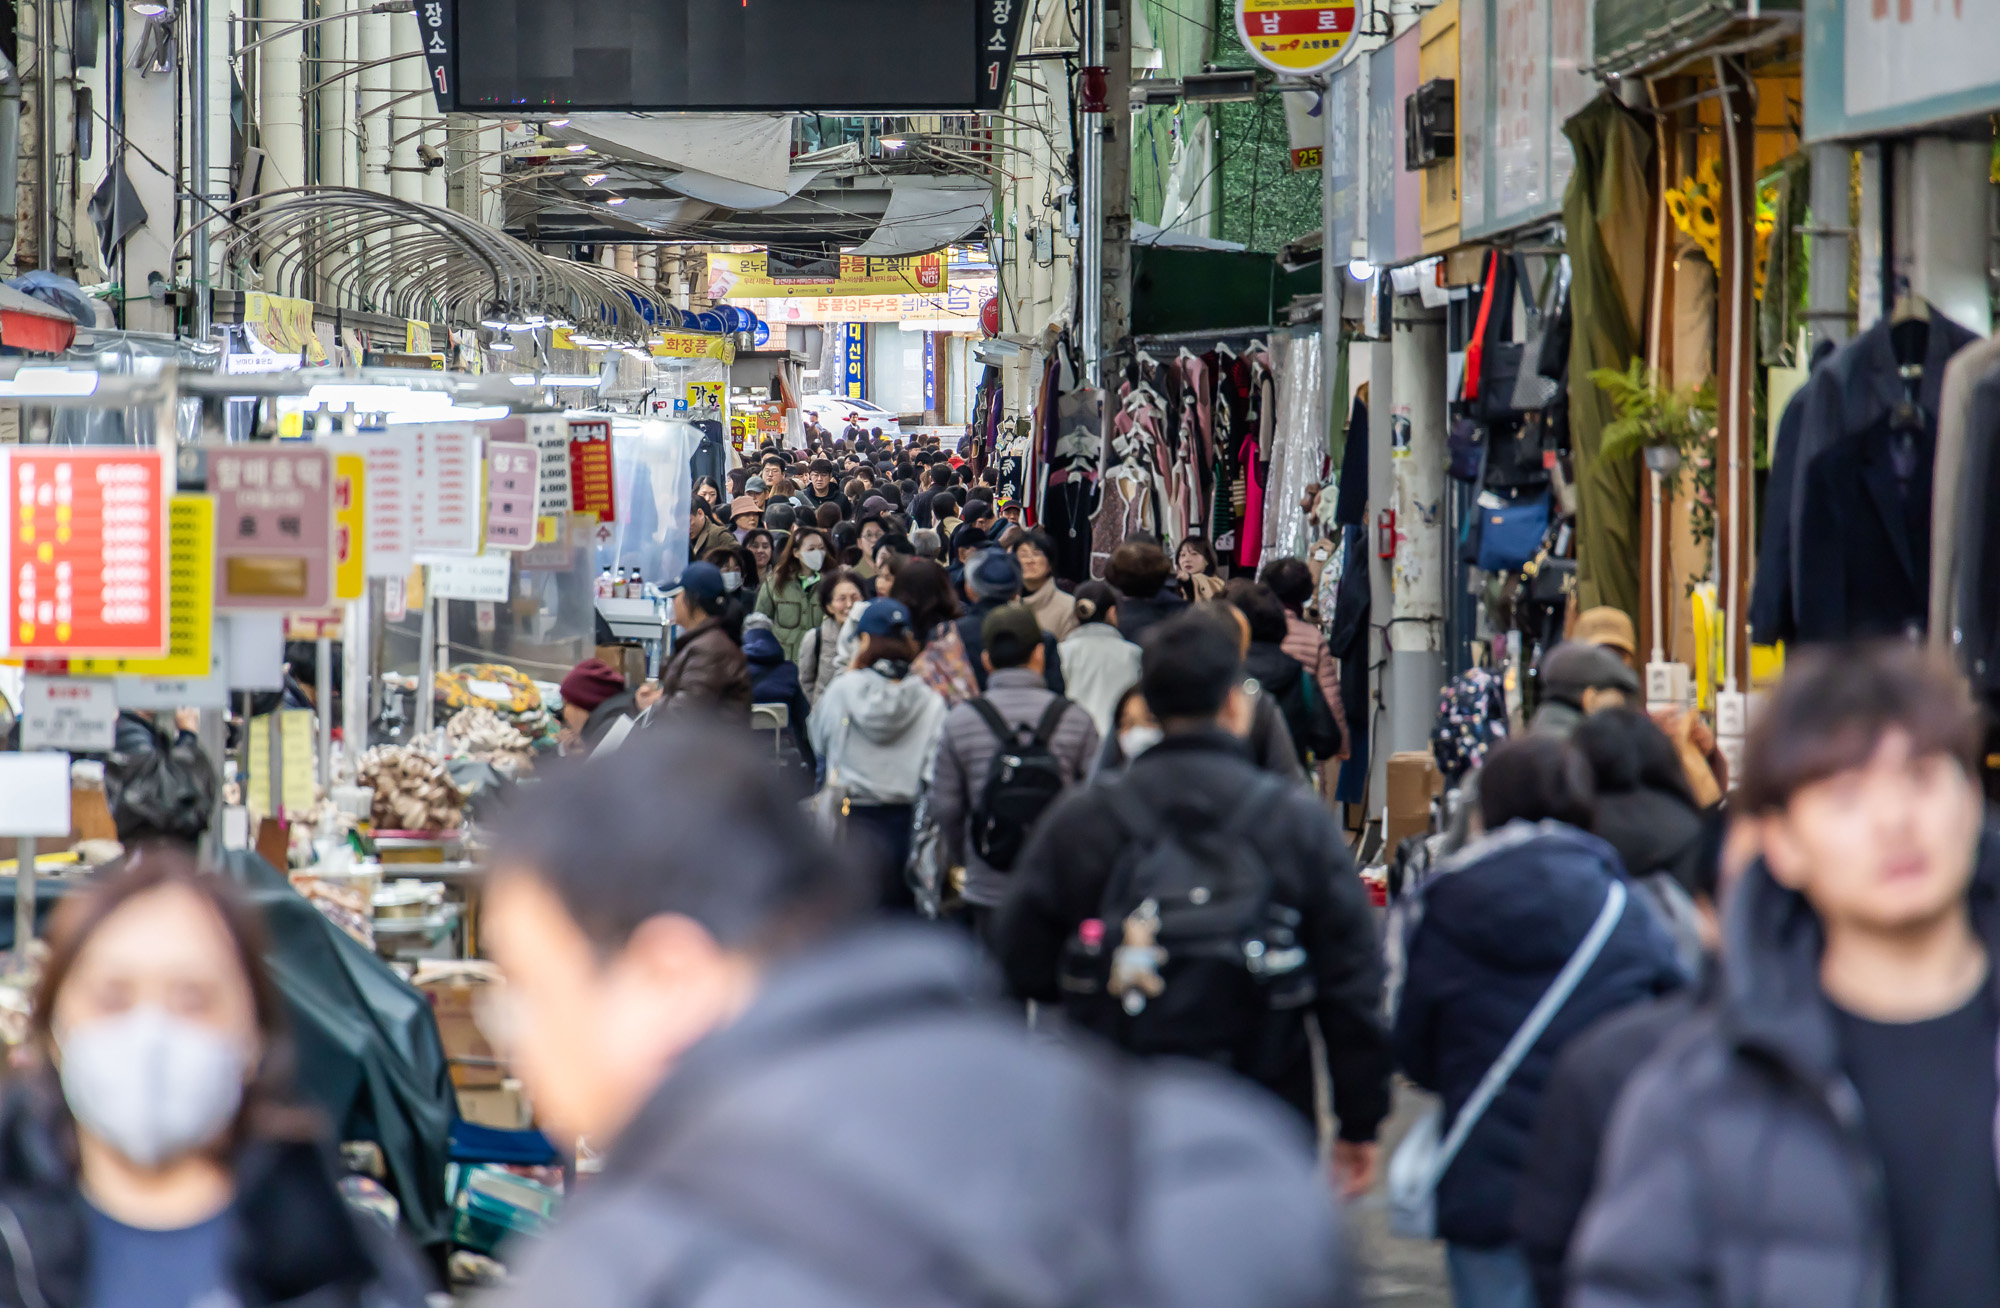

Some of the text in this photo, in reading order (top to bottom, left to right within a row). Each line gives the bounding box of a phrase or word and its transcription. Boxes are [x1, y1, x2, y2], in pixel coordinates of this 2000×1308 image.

[425, 2, 448, 94] 장소 1
[987, 0, 1012, 90] 장소 1
[1298, 148, 1323, 168] 25
[922, 274, 938, 284] NO!
[666, 337, 708, 354] 화장품
